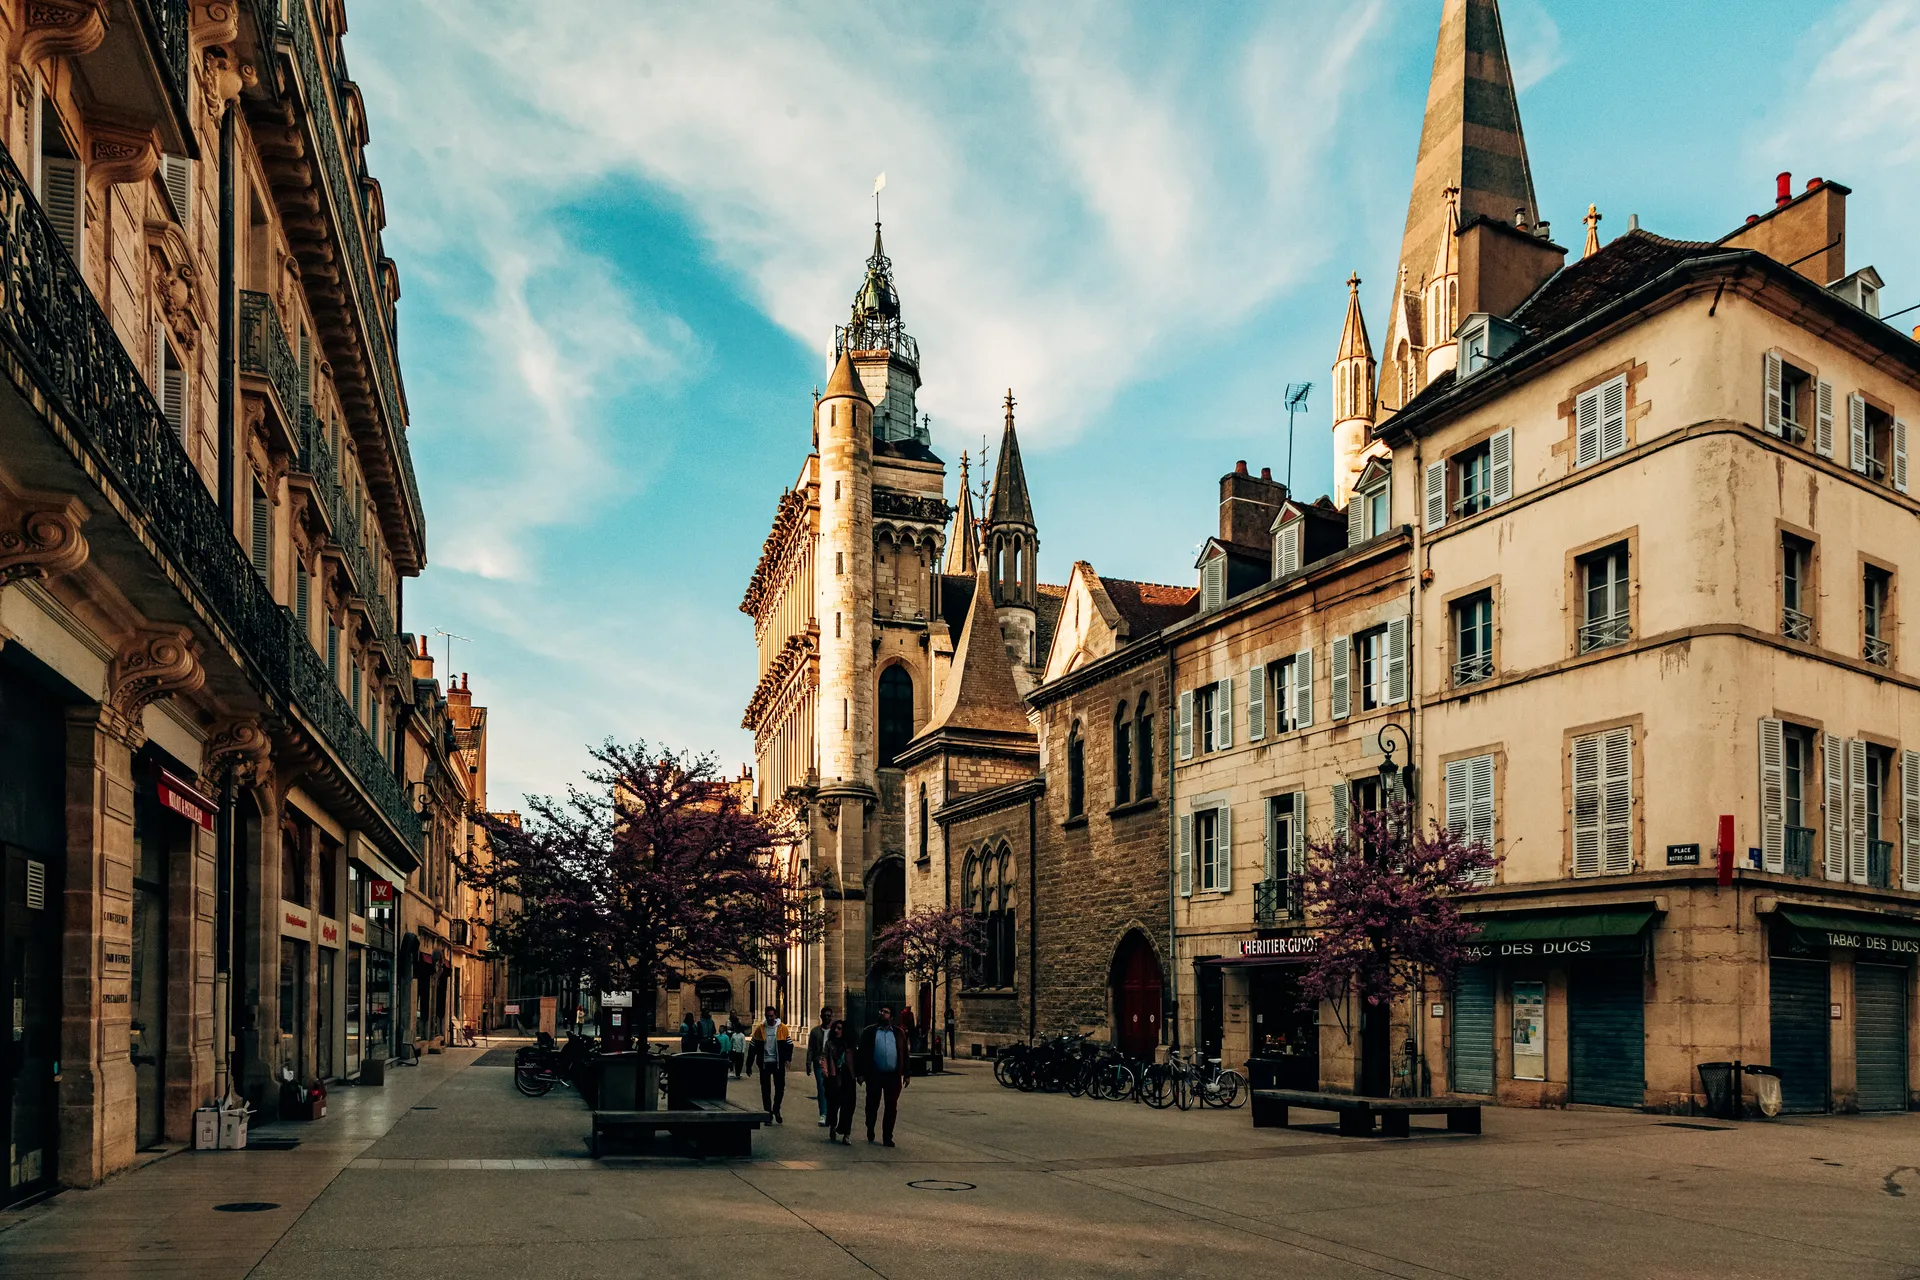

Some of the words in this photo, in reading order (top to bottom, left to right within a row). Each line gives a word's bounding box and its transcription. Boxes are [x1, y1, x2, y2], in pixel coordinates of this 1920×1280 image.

[1669, 854, 1696, 862] NOTRE-DAME
[1501, 943, 1533, 956] DES
[1543, 940, 1591, 955] DUCS
[1826, 932, 1861, 948] TABAC
[1866, 936, 1887, 950] DES
[1891, 939, 1920, 953] DUCS
